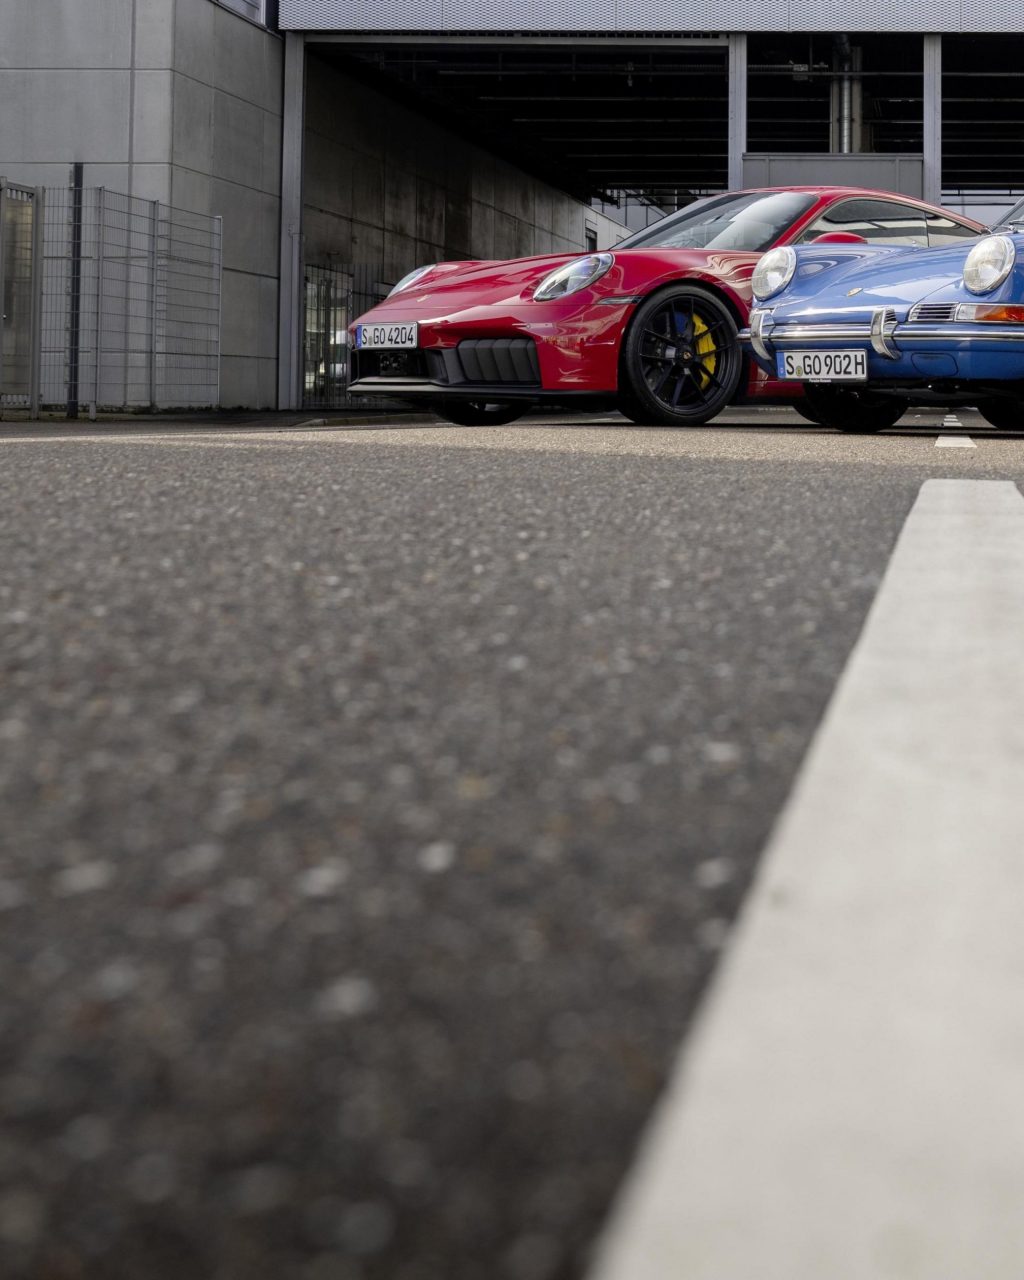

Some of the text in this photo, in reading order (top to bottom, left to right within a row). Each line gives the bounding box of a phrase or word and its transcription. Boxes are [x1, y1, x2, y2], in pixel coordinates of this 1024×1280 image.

[362, 328, 368, 345] S
[388, 327, 413, 345] 4204
[786, 355, 795, 376] S
